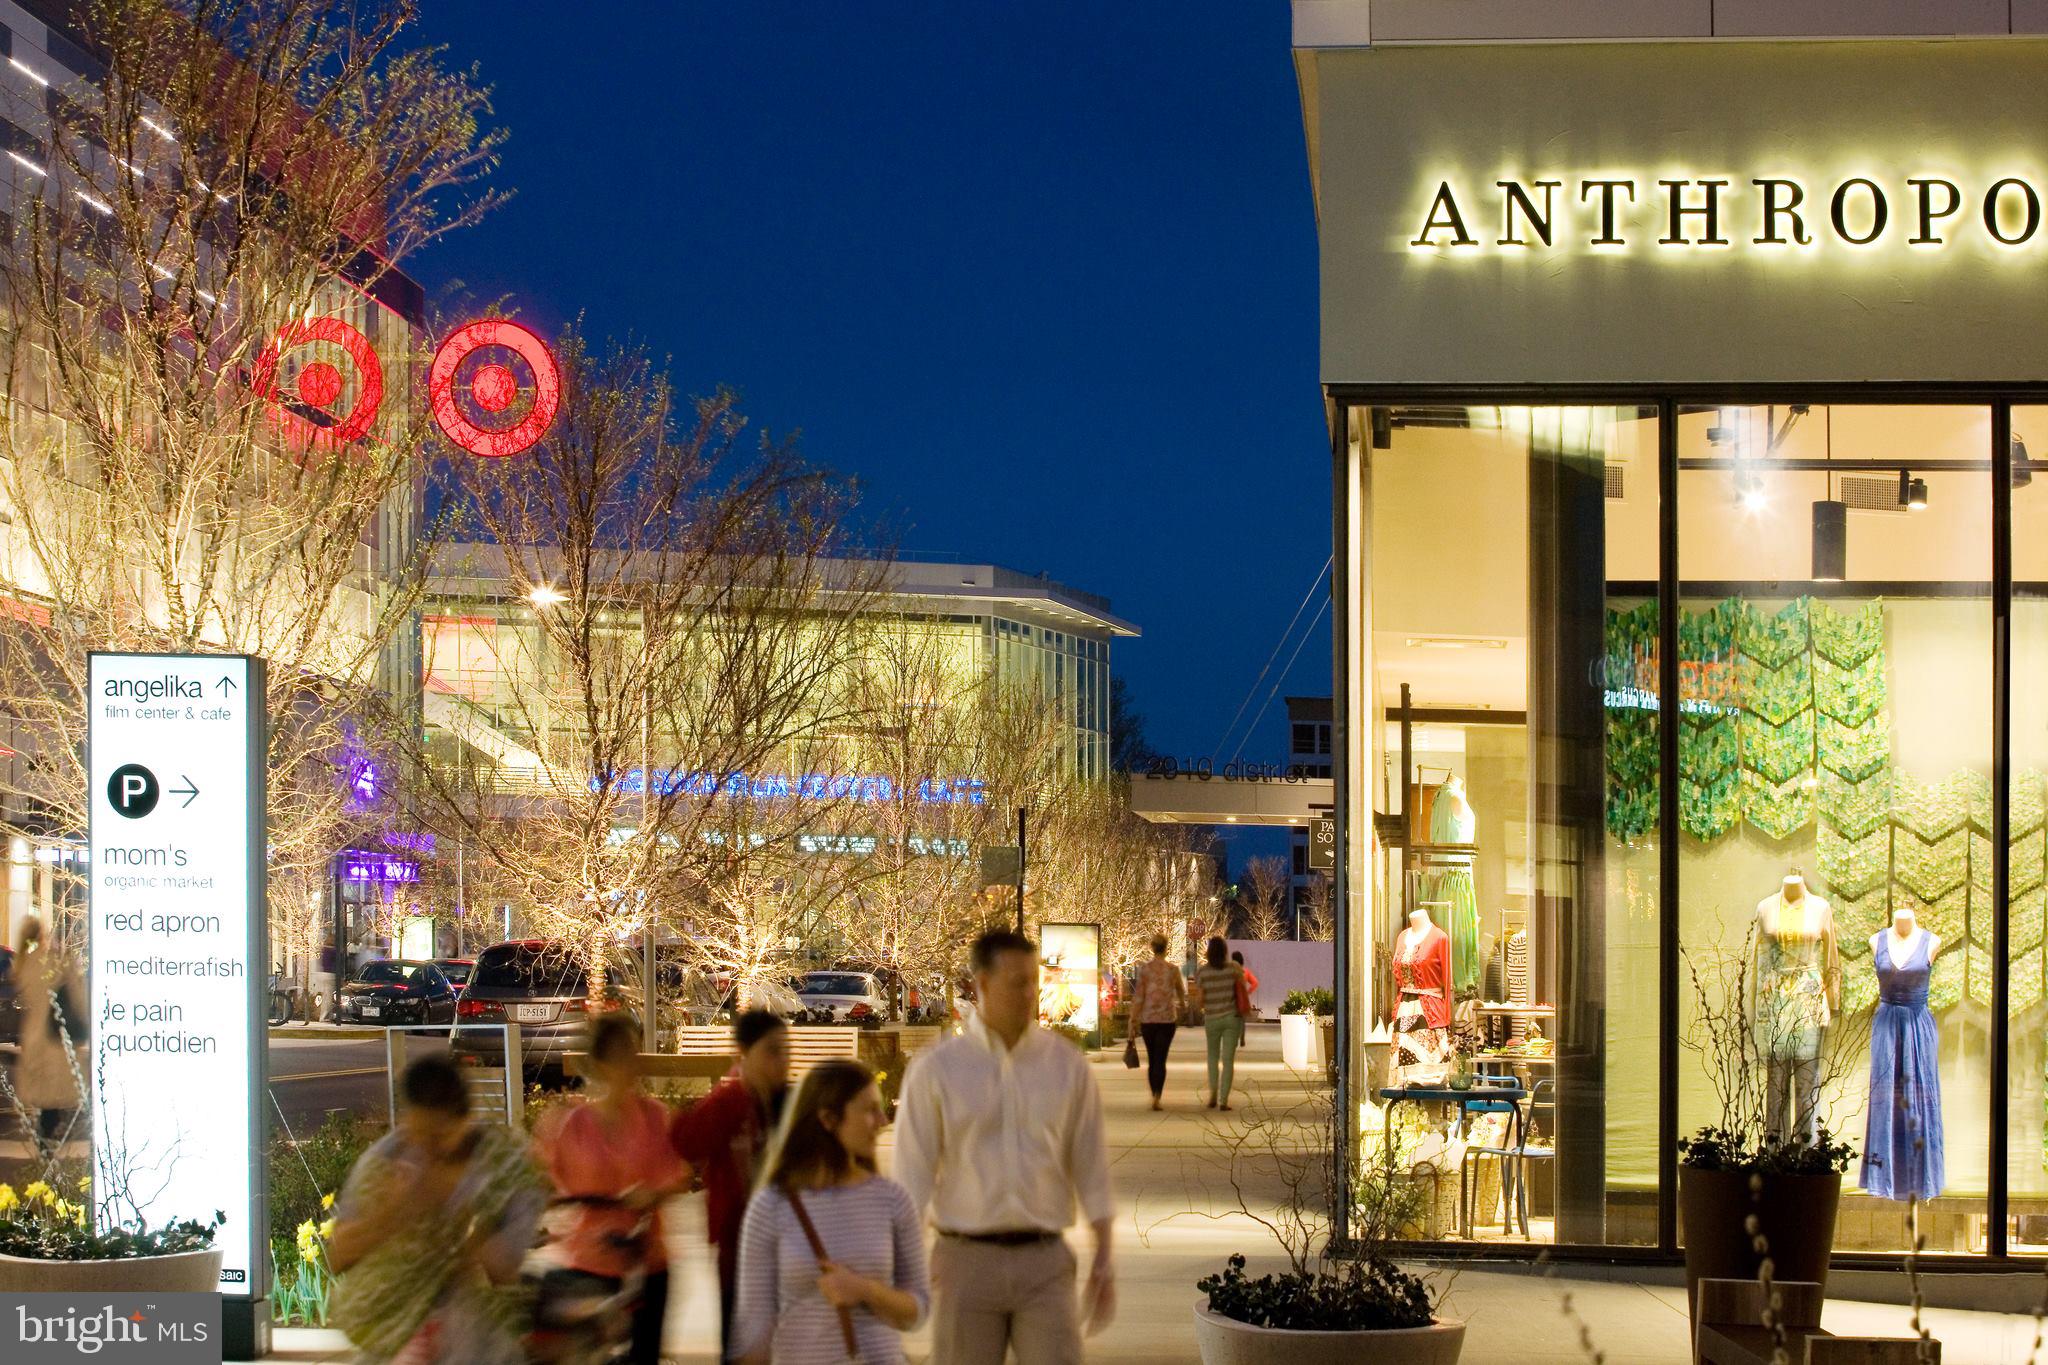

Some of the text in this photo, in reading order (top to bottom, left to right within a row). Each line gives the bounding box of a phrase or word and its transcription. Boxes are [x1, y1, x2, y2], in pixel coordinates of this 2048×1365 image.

[1411, 178, 2040, 246] ANTHROPO
[104, 674, 203, 703] angelika
[105, 704, 231, 720] film center & cafe
[1222, 756, 1310, 784] district
[122, 774, 147, 808] P
[104, 843, 188, 867] mom's
[104, 876, 213, 891] organic market
[105, 908, 220, 938] red apron
[106, 956, 243, 977] mediterrafish
[133, 999, 183, 1027] pain
[106, 1030, 217, 1057] quotidien
